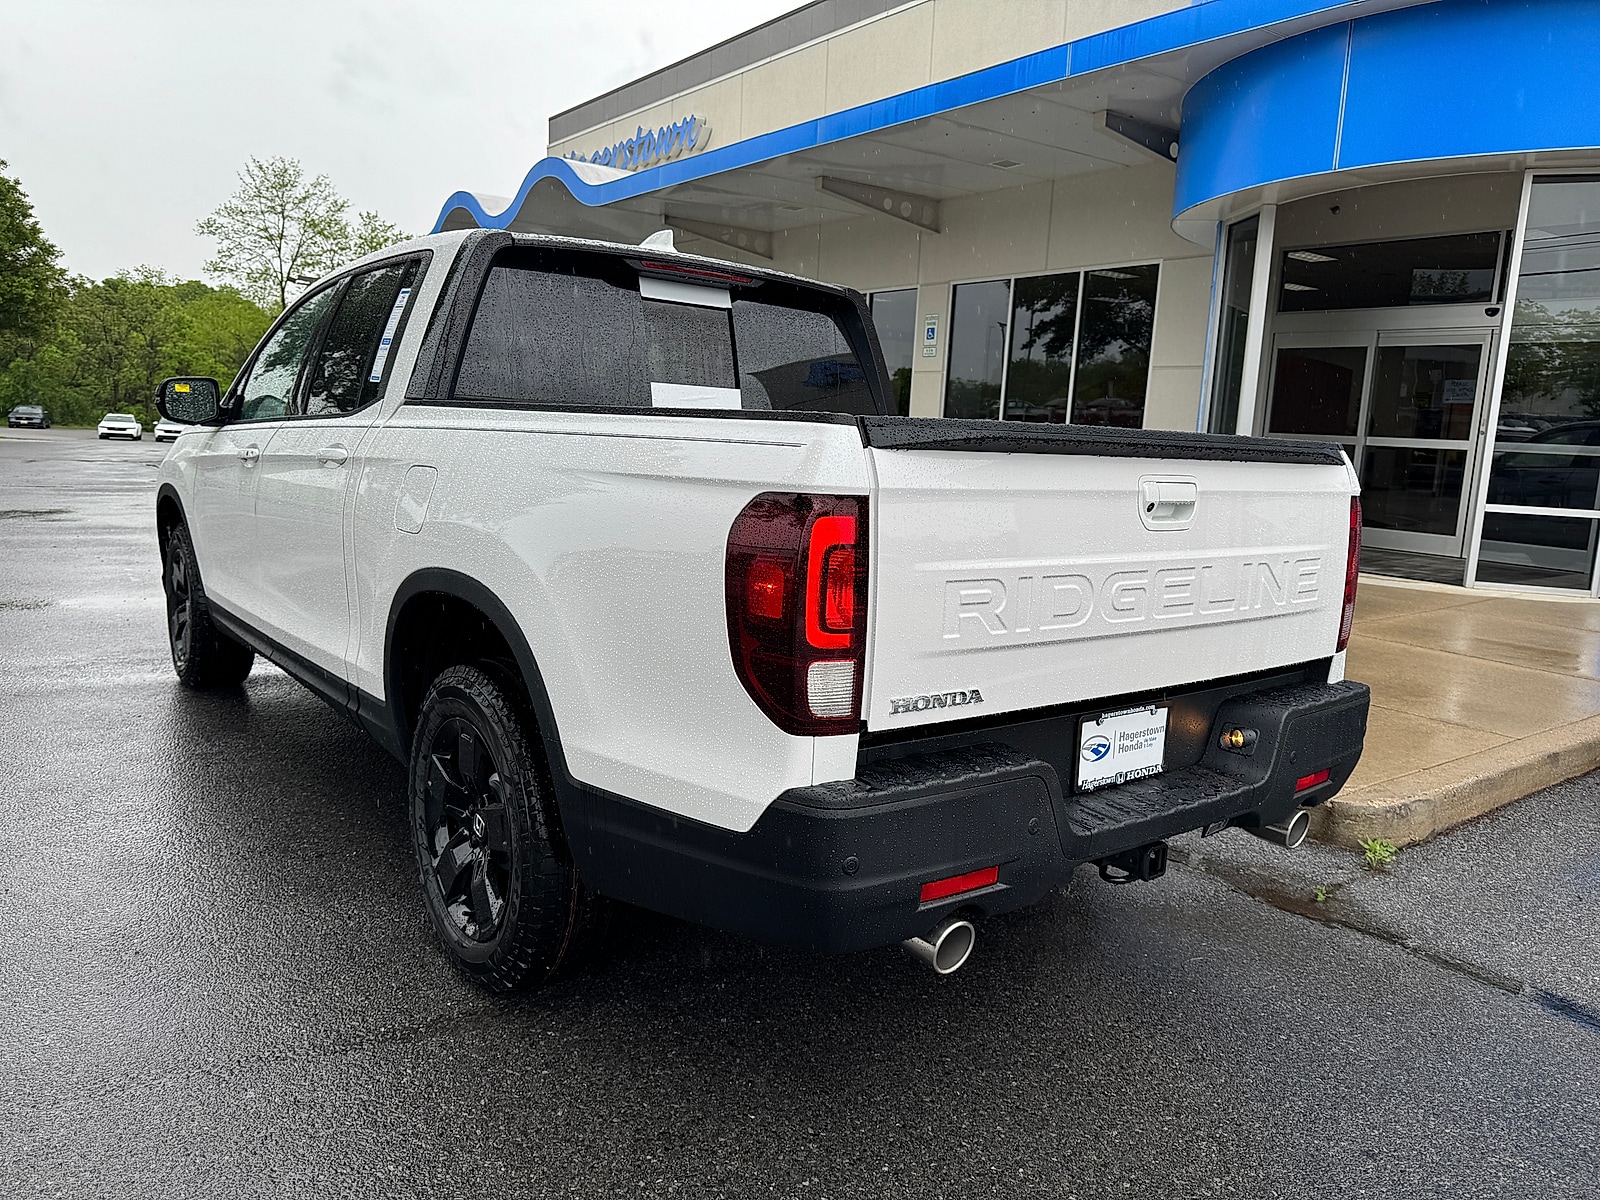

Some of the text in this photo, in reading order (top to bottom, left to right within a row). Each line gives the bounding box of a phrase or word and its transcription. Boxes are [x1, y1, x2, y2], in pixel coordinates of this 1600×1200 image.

[563, 114, 700, 170] erstown
[942, 557, 1321, 639] RIDGELINE
[889, 689, 984, 716] HONDA
[1118, 740, 1143, 754] Honda
[1119, 726, 1164, 742] Hagerstown
[1081, 765, 1163, 791] Hagerstown HONDA
